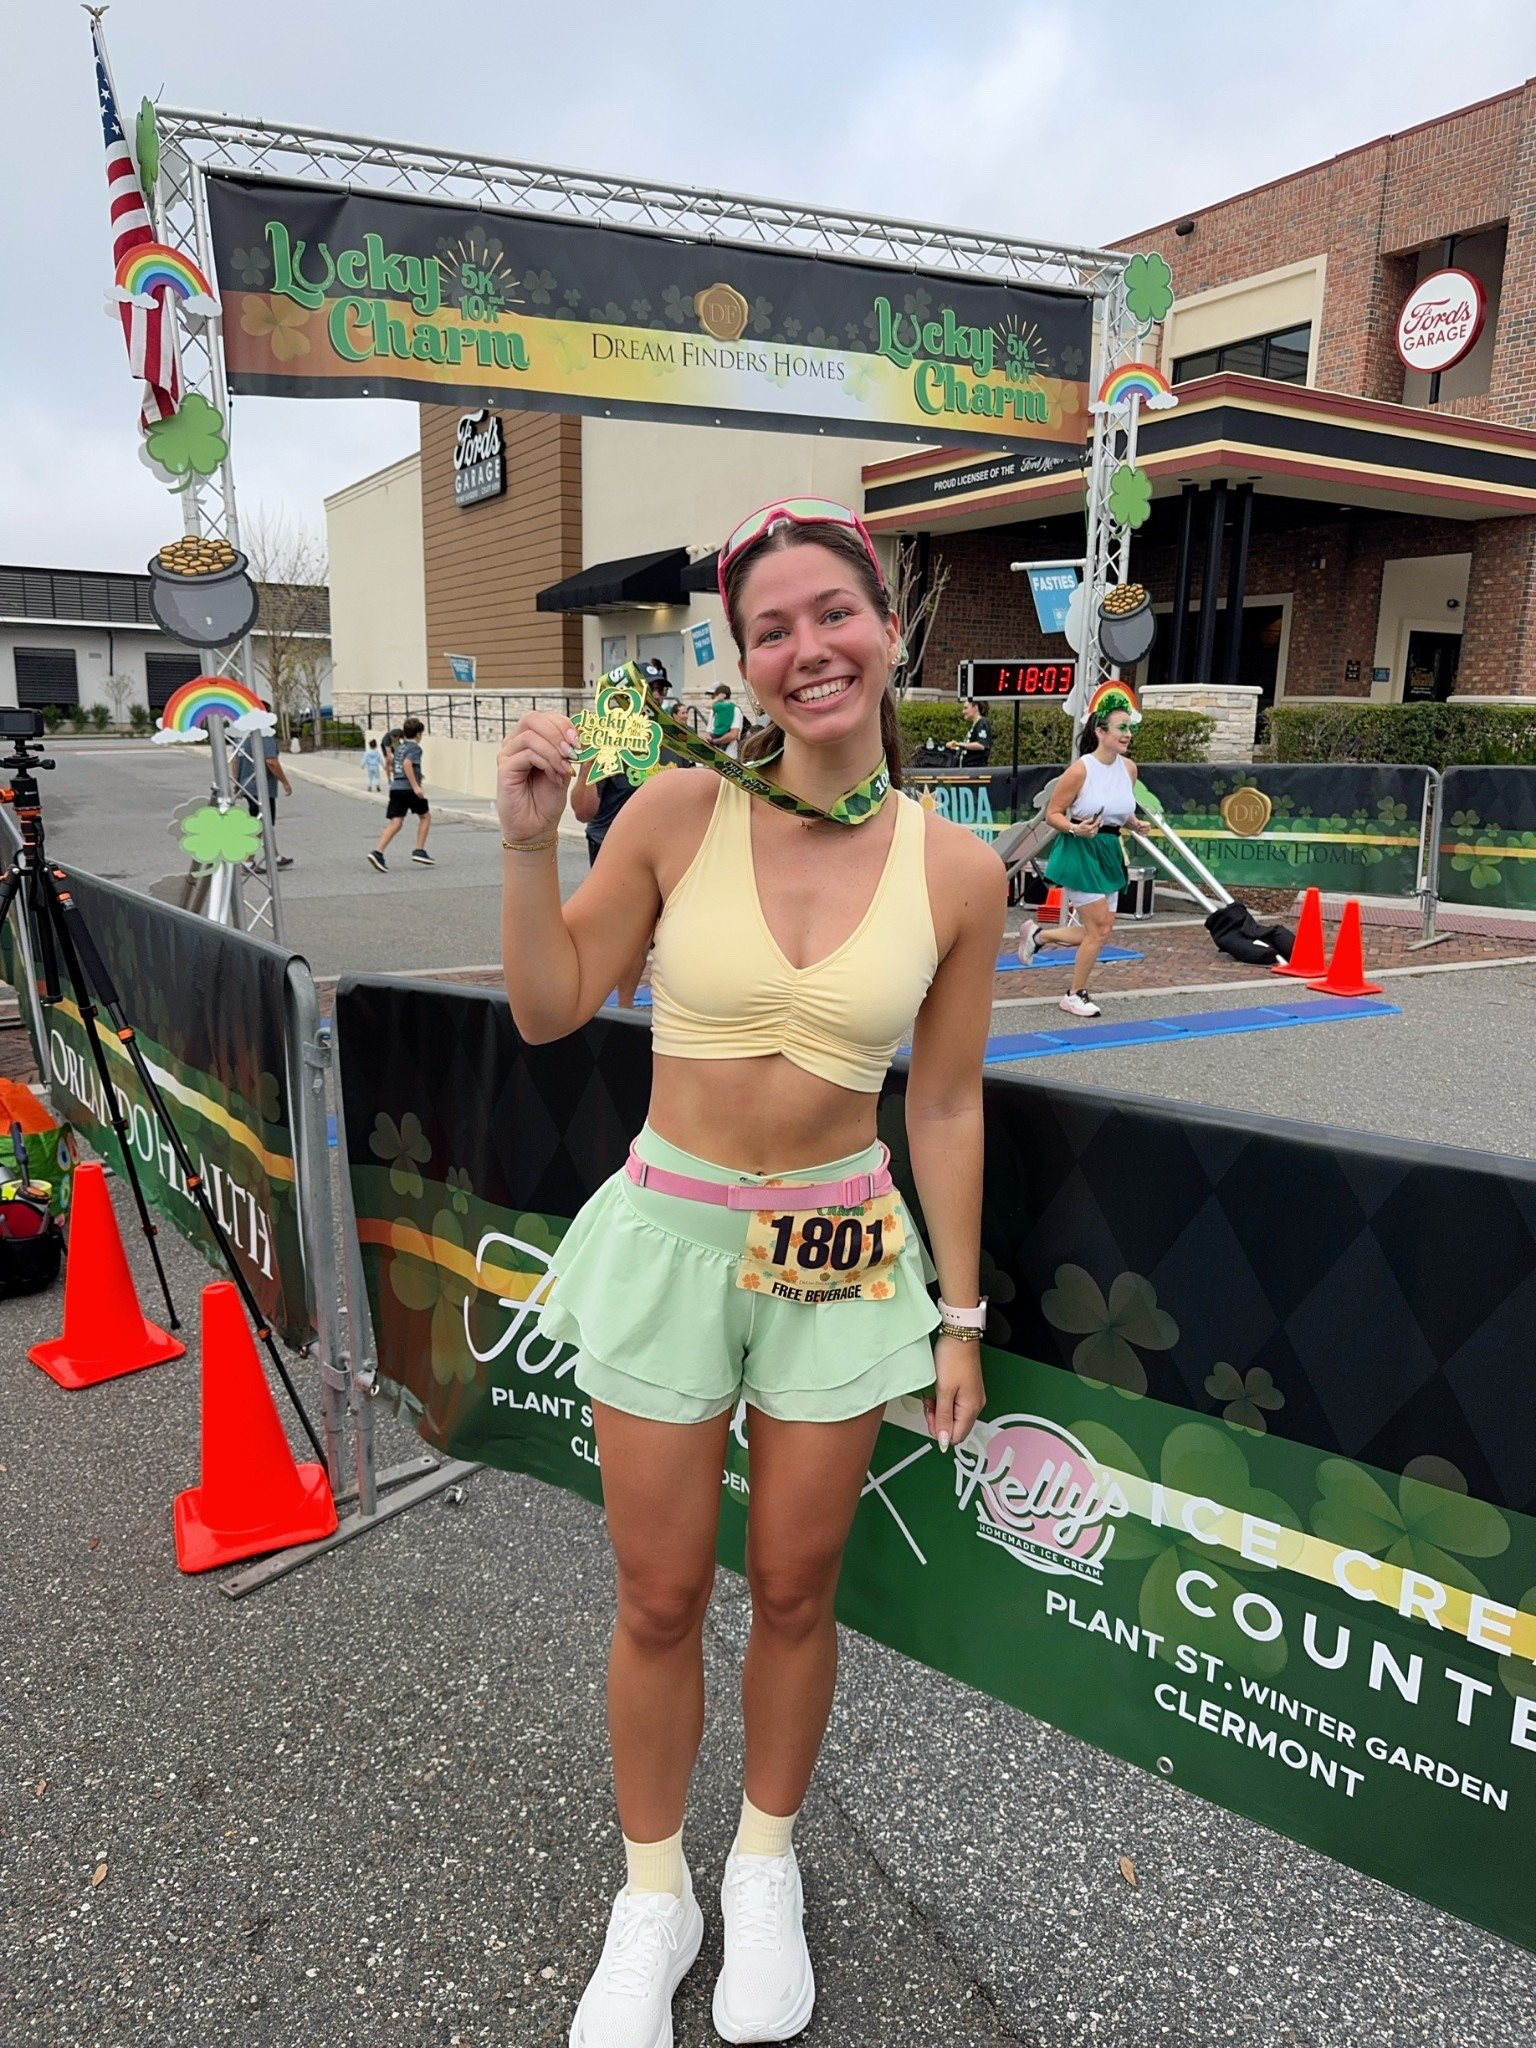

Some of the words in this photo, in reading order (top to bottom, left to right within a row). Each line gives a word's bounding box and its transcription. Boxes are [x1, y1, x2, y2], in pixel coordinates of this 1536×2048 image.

[265, 221, 442, 316] Lucky
[461, 263, 495, 295] 5K
[458, 295, 500, 323] 10K
[708, 302, 738, 324] DF
[1403, 298, 1472, 335] Ford's
[329, 296, 530, 370] Charm
[874, 297, 994, 376] Lucky
[1007, 333, 1030, 360] 5K
[1403, 324, 1467, 351] GARAGE
[592, 333, 675, 363] DREAM
[682, 342, 767, 373] FINDERS
[774, 352, 845, 381] HOMES
[1005, 360, 1031, 384] 10K
[914, 360, 1049, 424] Charm
[454, 409, 501, 470] Ford's
[455, 458, 500, 493] GARAGE
[933, 477, 956, 491] PROUD
[957, 469, 989, 486] LICENSEE
[989, 467, 1000, 479] OF
[1001, 464, 1015, 476] THE
[1020, 456, 1042, 472] Ford
[1032, 575, 1076, 591] FASTIES
[999, 667, 1072, 692] 1:18:03
[592, 729, 648, 749] Charm
[723, 761, 770, 791] ORLANDO
[1234, 804, 1261, 822] DF
[1202, 839, 1287, 862] FINDERS
[1294, 845, 1368, 865] HOMES
[771, 1215, 884, 1271] 1801
[772, 1282, 803, 1302] FREE
[804, 1284, 862, 1303] BEVERAGE
[491, 1386, 576, 1420] PLANT
[954, 1434, 1130, 1546] Kelly's
[979, 1523, 1036, 1554] HOMEMADE
[1041, 1548, 1059, 1563] ICE
[1063, 1556, 1101, 1579] CREAM
[1150, 1482, 1281, 1569] ICE
[1333, 1550, 1536, 1666] CRE
[1046, 1589, 1164, 1659] PLANT
[1175, 1644, 1233, 1691] ST.
[1240, 1676, 1357, 1749] WINTER
[1365, 1737, 1509, 1812] GARDEN
[1154, 1683, 1365, 1798] CLERMONT
